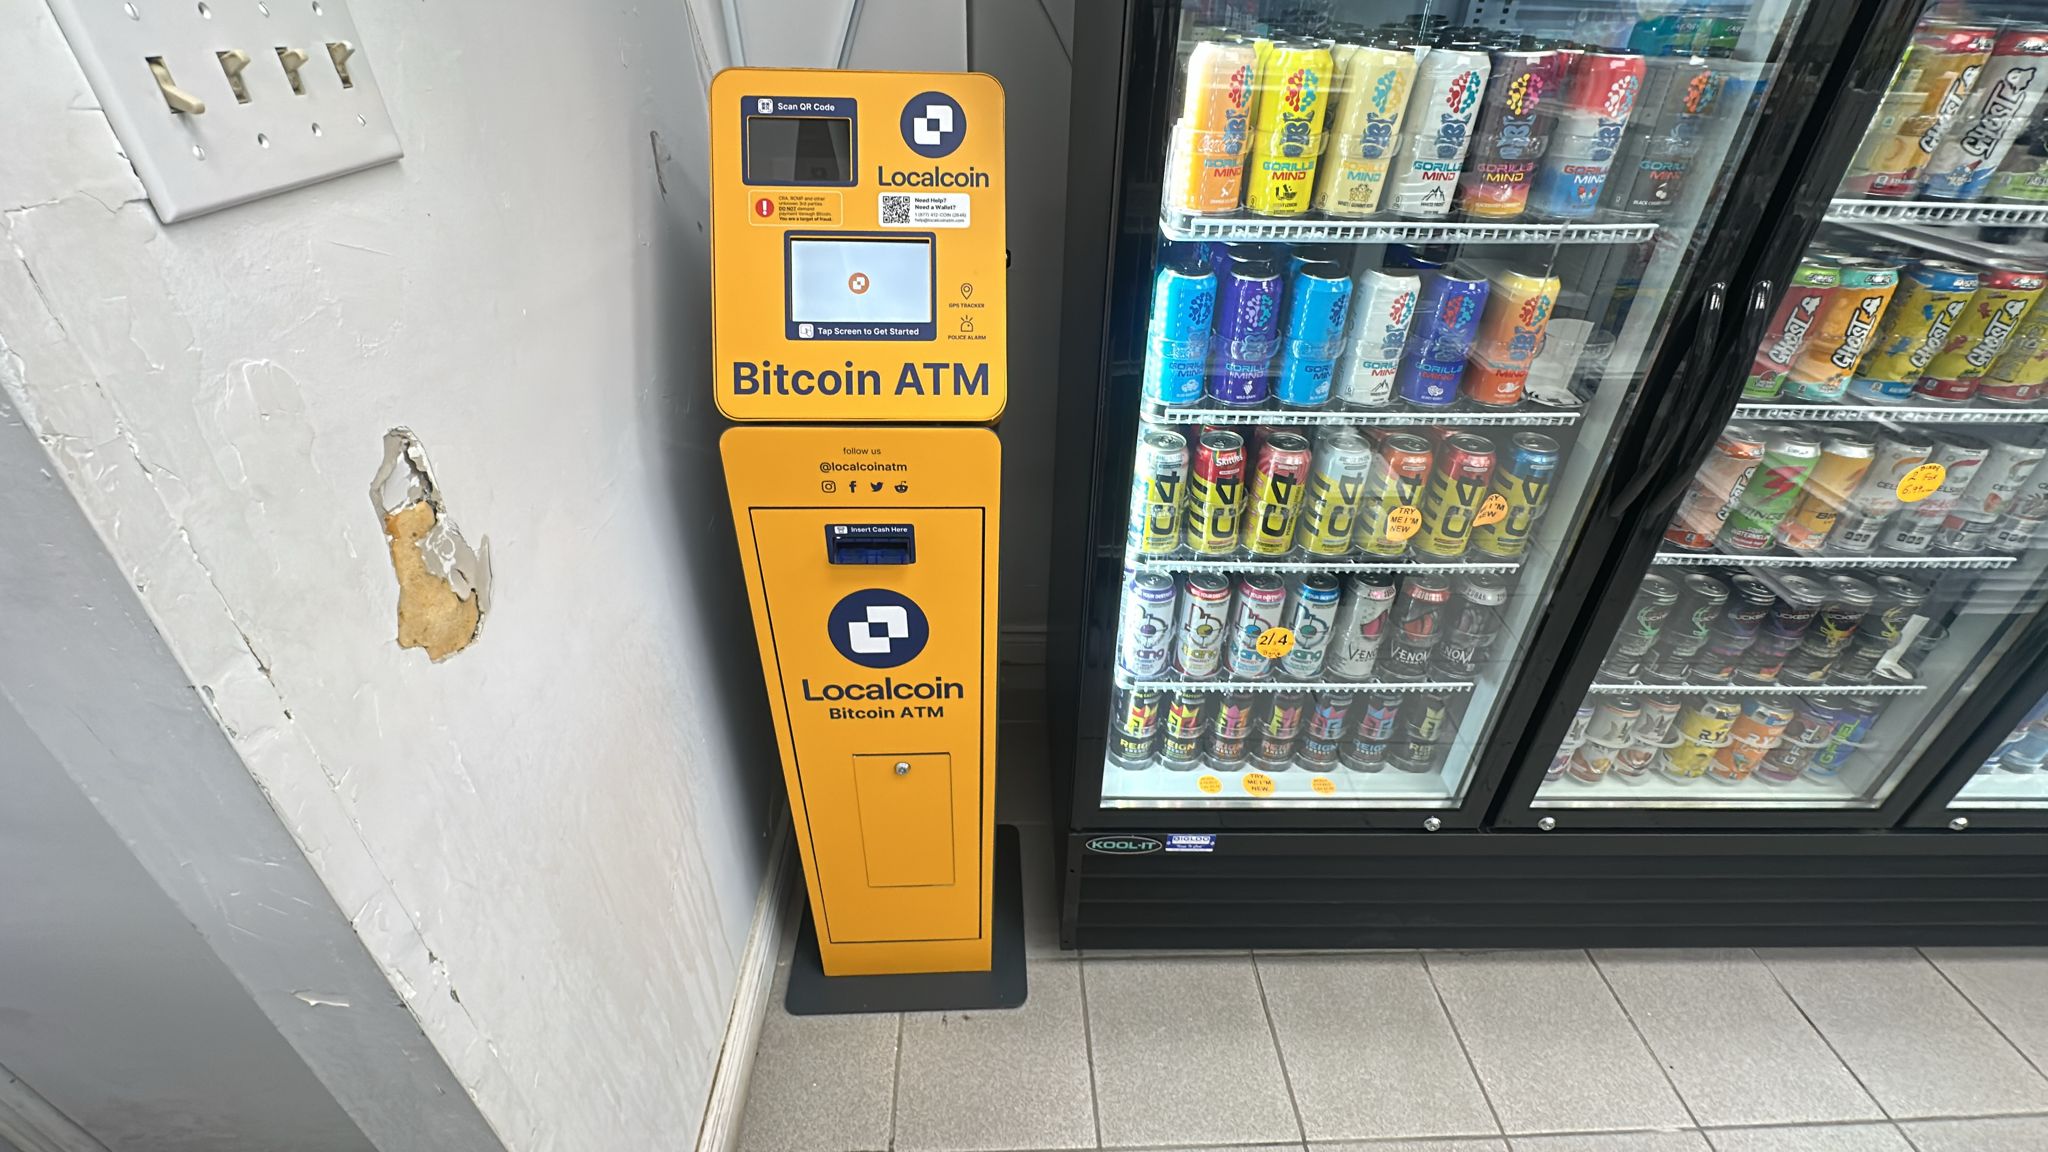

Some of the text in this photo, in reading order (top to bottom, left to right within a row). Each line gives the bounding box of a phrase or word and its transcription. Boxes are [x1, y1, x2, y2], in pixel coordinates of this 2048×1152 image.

[778, 103, 835, 112] Scan QR Code
[1961, 80, 2025, 159] GHOST
[878, 165, 989, 188] Localcoin
[1214, 166, 1242, 177] MIND
[1271, 171, 1307, 180] MIND
[1347, 171, 1382, 182] MIND
[1422, 171, 1456, 181] MIND
[1486, 172, 1524, 182] MIND
[1573, 174, 1607, 184] MIND
[818, 327, 919, 337] Tap Screen to Get Started
[1768, 306, 1815, 365] GHOST
[1966, 308, 2019, 369] GHOST
[1831, 308, 1877, 370] GHOST
[1910, 311, 1951, 368] GHOST
[733, 360, 989, 396] Bitcoin ATM
[1233, 371, 1264, 379] MIND
[843, 447, 868, 455] follow
[1216, 454, 1244, 467] Skittles
[819, 462, 908, 473] @localcoinatm
[1211, 474, 1239, 538] C4
[1262, 472, 1298, 537] C4
[1328, 472, 1365, 537] C4
[1441, 474, 1484, 538] C4
[1390, 525, 1411, 533] NEW
[1444, 646, 1475, 664] NOM
[802, 677, 964, 701] Localcoin
[829, 706, 944, 720] Bitcoin ATM
[1091, 841, 1157, 850] KOOL-IT
